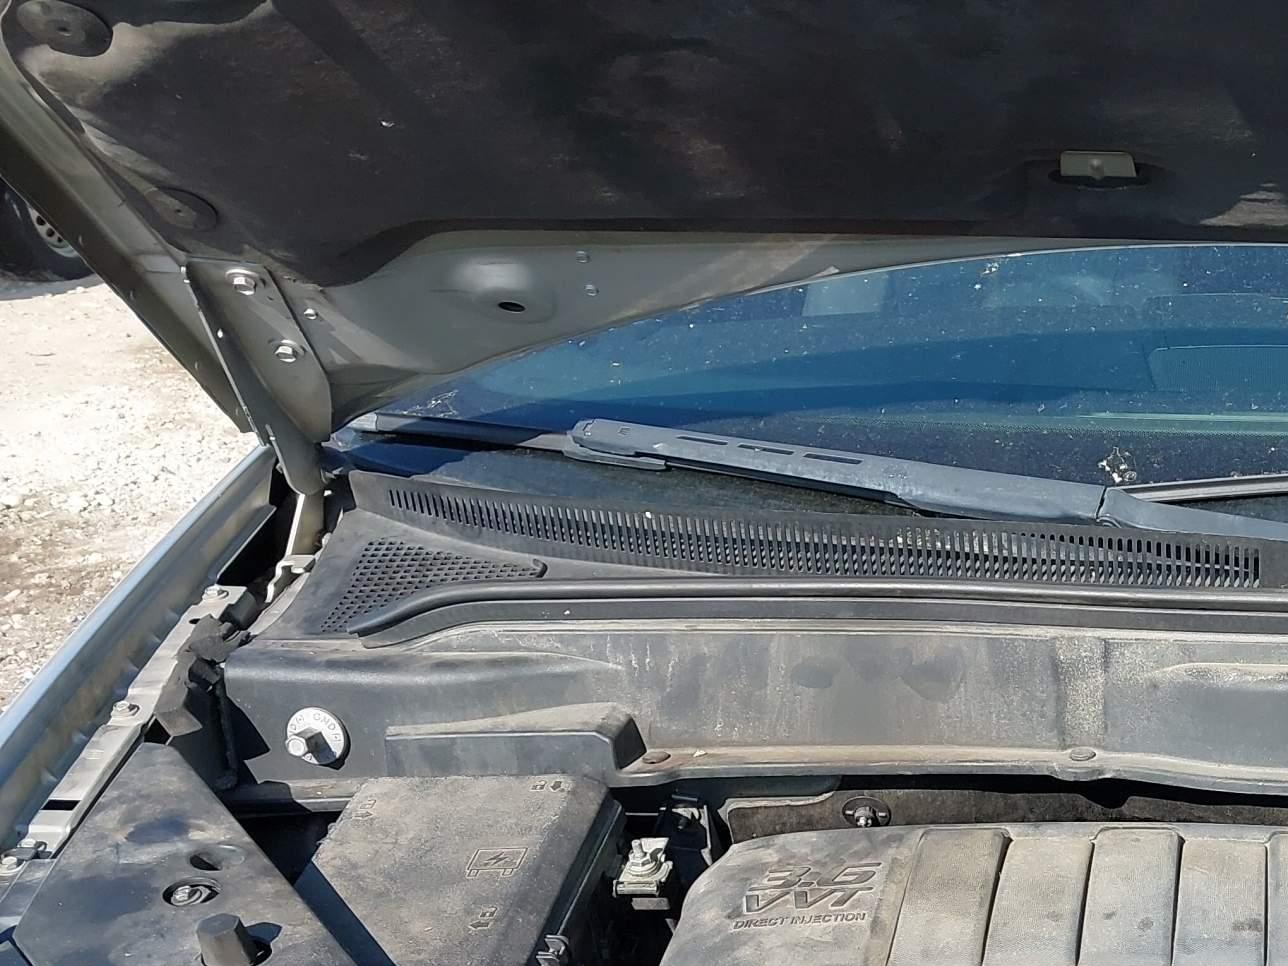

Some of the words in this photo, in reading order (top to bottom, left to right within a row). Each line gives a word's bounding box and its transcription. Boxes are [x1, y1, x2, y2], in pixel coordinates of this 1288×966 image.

[749, 862, 882, 891] 3.6
[744, 887, 874, 914] VVT
[732, 916, 787, 930] DIRECT
[789, 912, 866, 925] INJECTION
